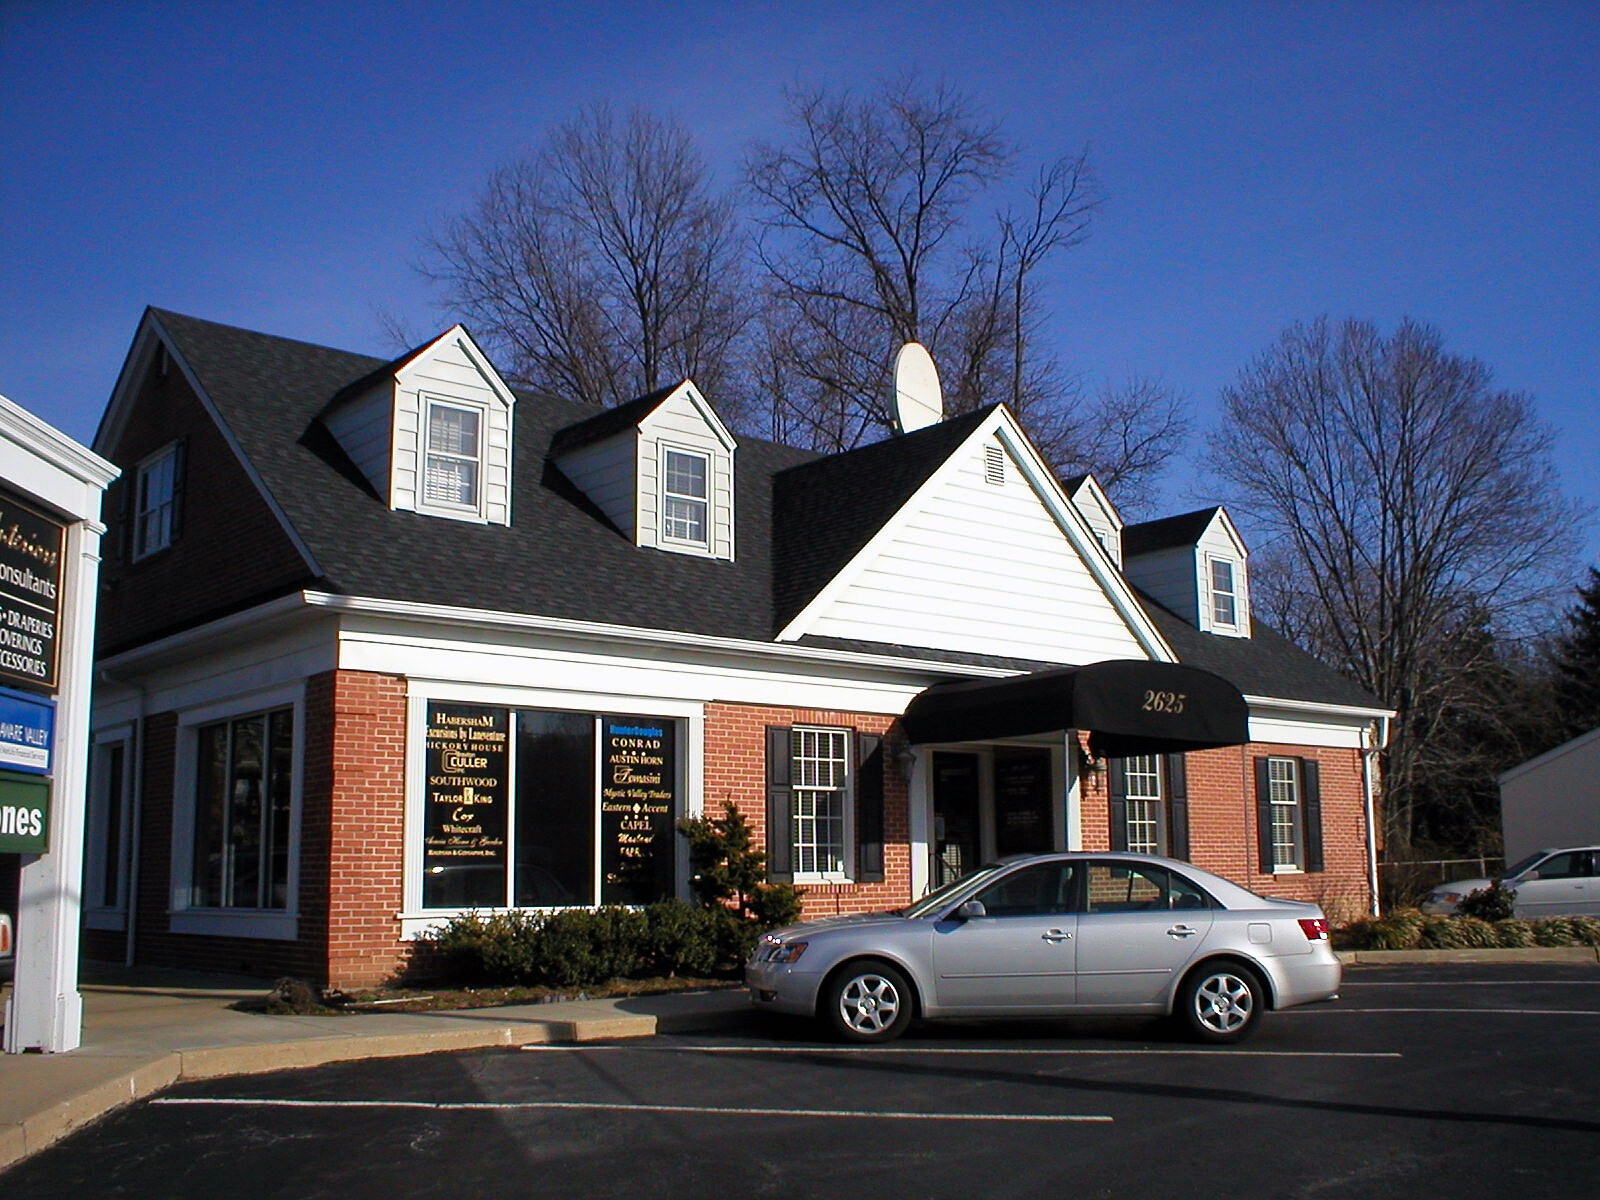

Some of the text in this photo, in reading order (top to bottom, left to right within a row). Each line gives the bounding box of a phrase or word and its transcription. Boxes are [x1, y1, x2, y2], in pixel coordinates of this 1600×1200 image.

[7, 610, 54, 639] DRAPERIES
[0, 649, 47, 677] CESSORIES
[1142, 689, 1187, 714] 2625
[470, 743, 504, 752] HOUSE
[611, 737, 661, 749] CONRAD
[450, 756, 488, 769] CULLER
[609, 755, 664, 765] AUSTIN HORN
[430, 776, 497, 787] SOUTHWOOD
[432, 792, 464, 804] TAYLOR
[0, 805, 43, 837] nes
